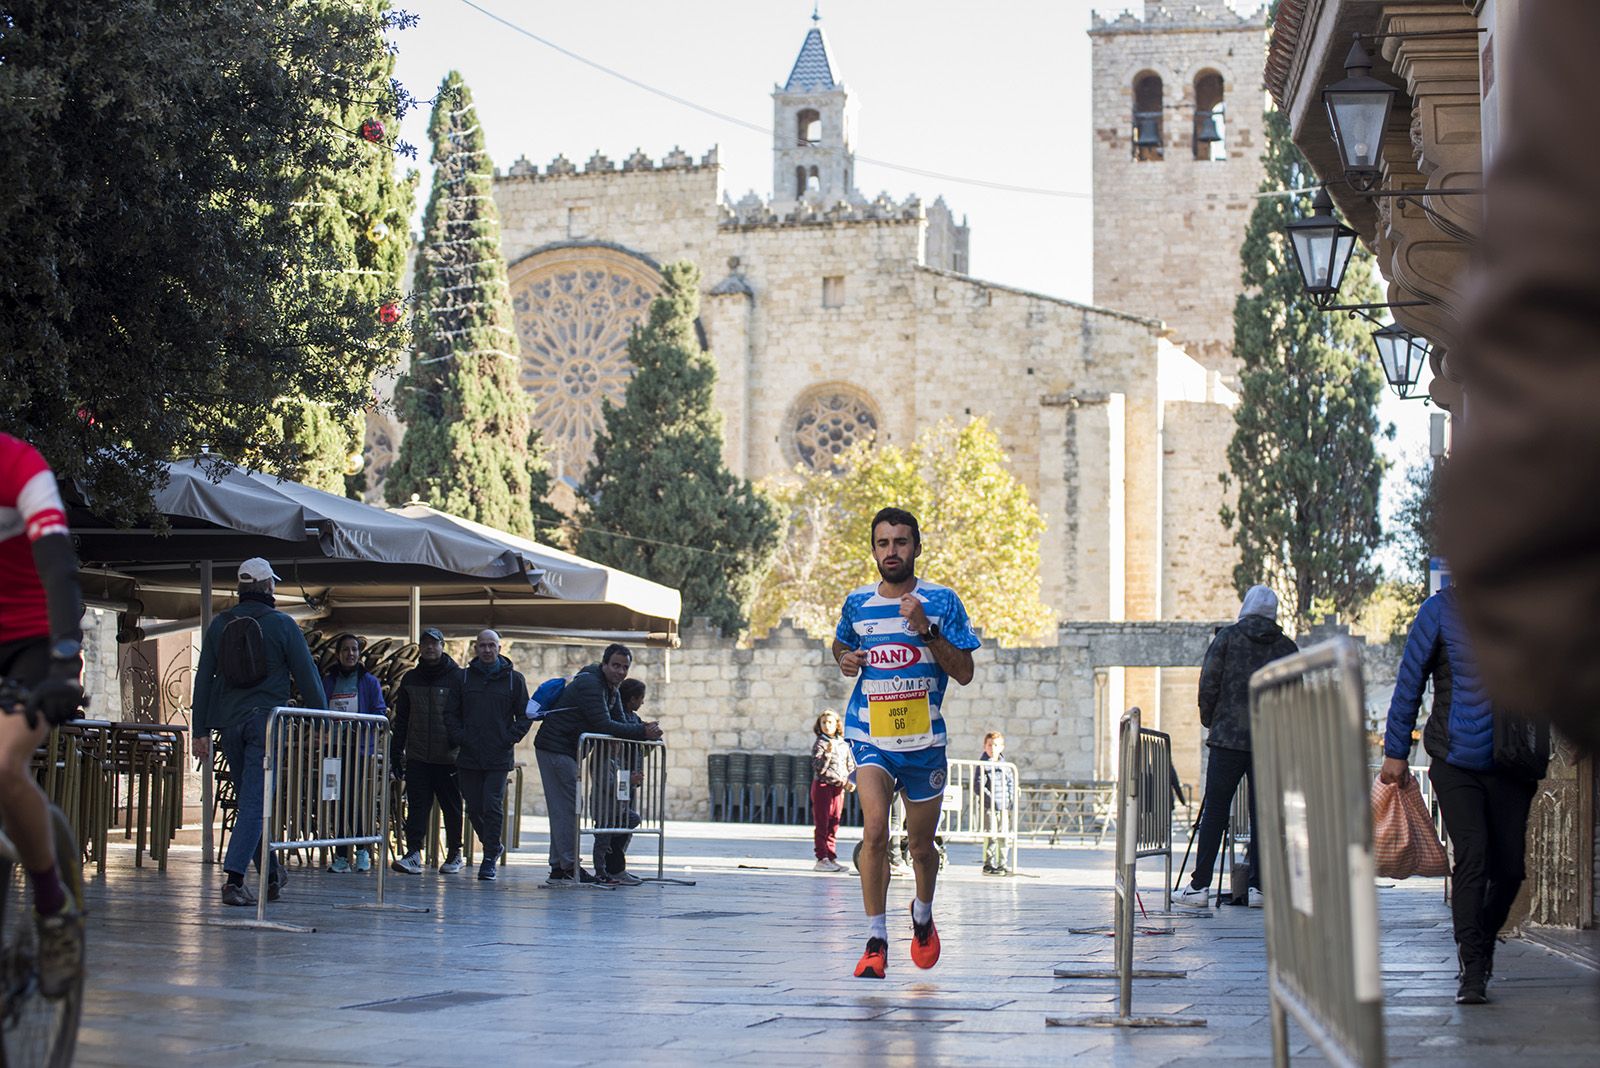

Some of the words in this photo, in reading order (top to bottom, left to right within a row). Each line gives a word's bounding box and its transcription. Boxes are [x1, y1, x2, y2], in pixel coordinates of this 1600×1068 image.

[870, 649, 908, 665] DANI
[899, 691, 918, 699] CUGAT
[888, 706, 909, 717] JOSEP
[894, 718, 906, 730] 66
